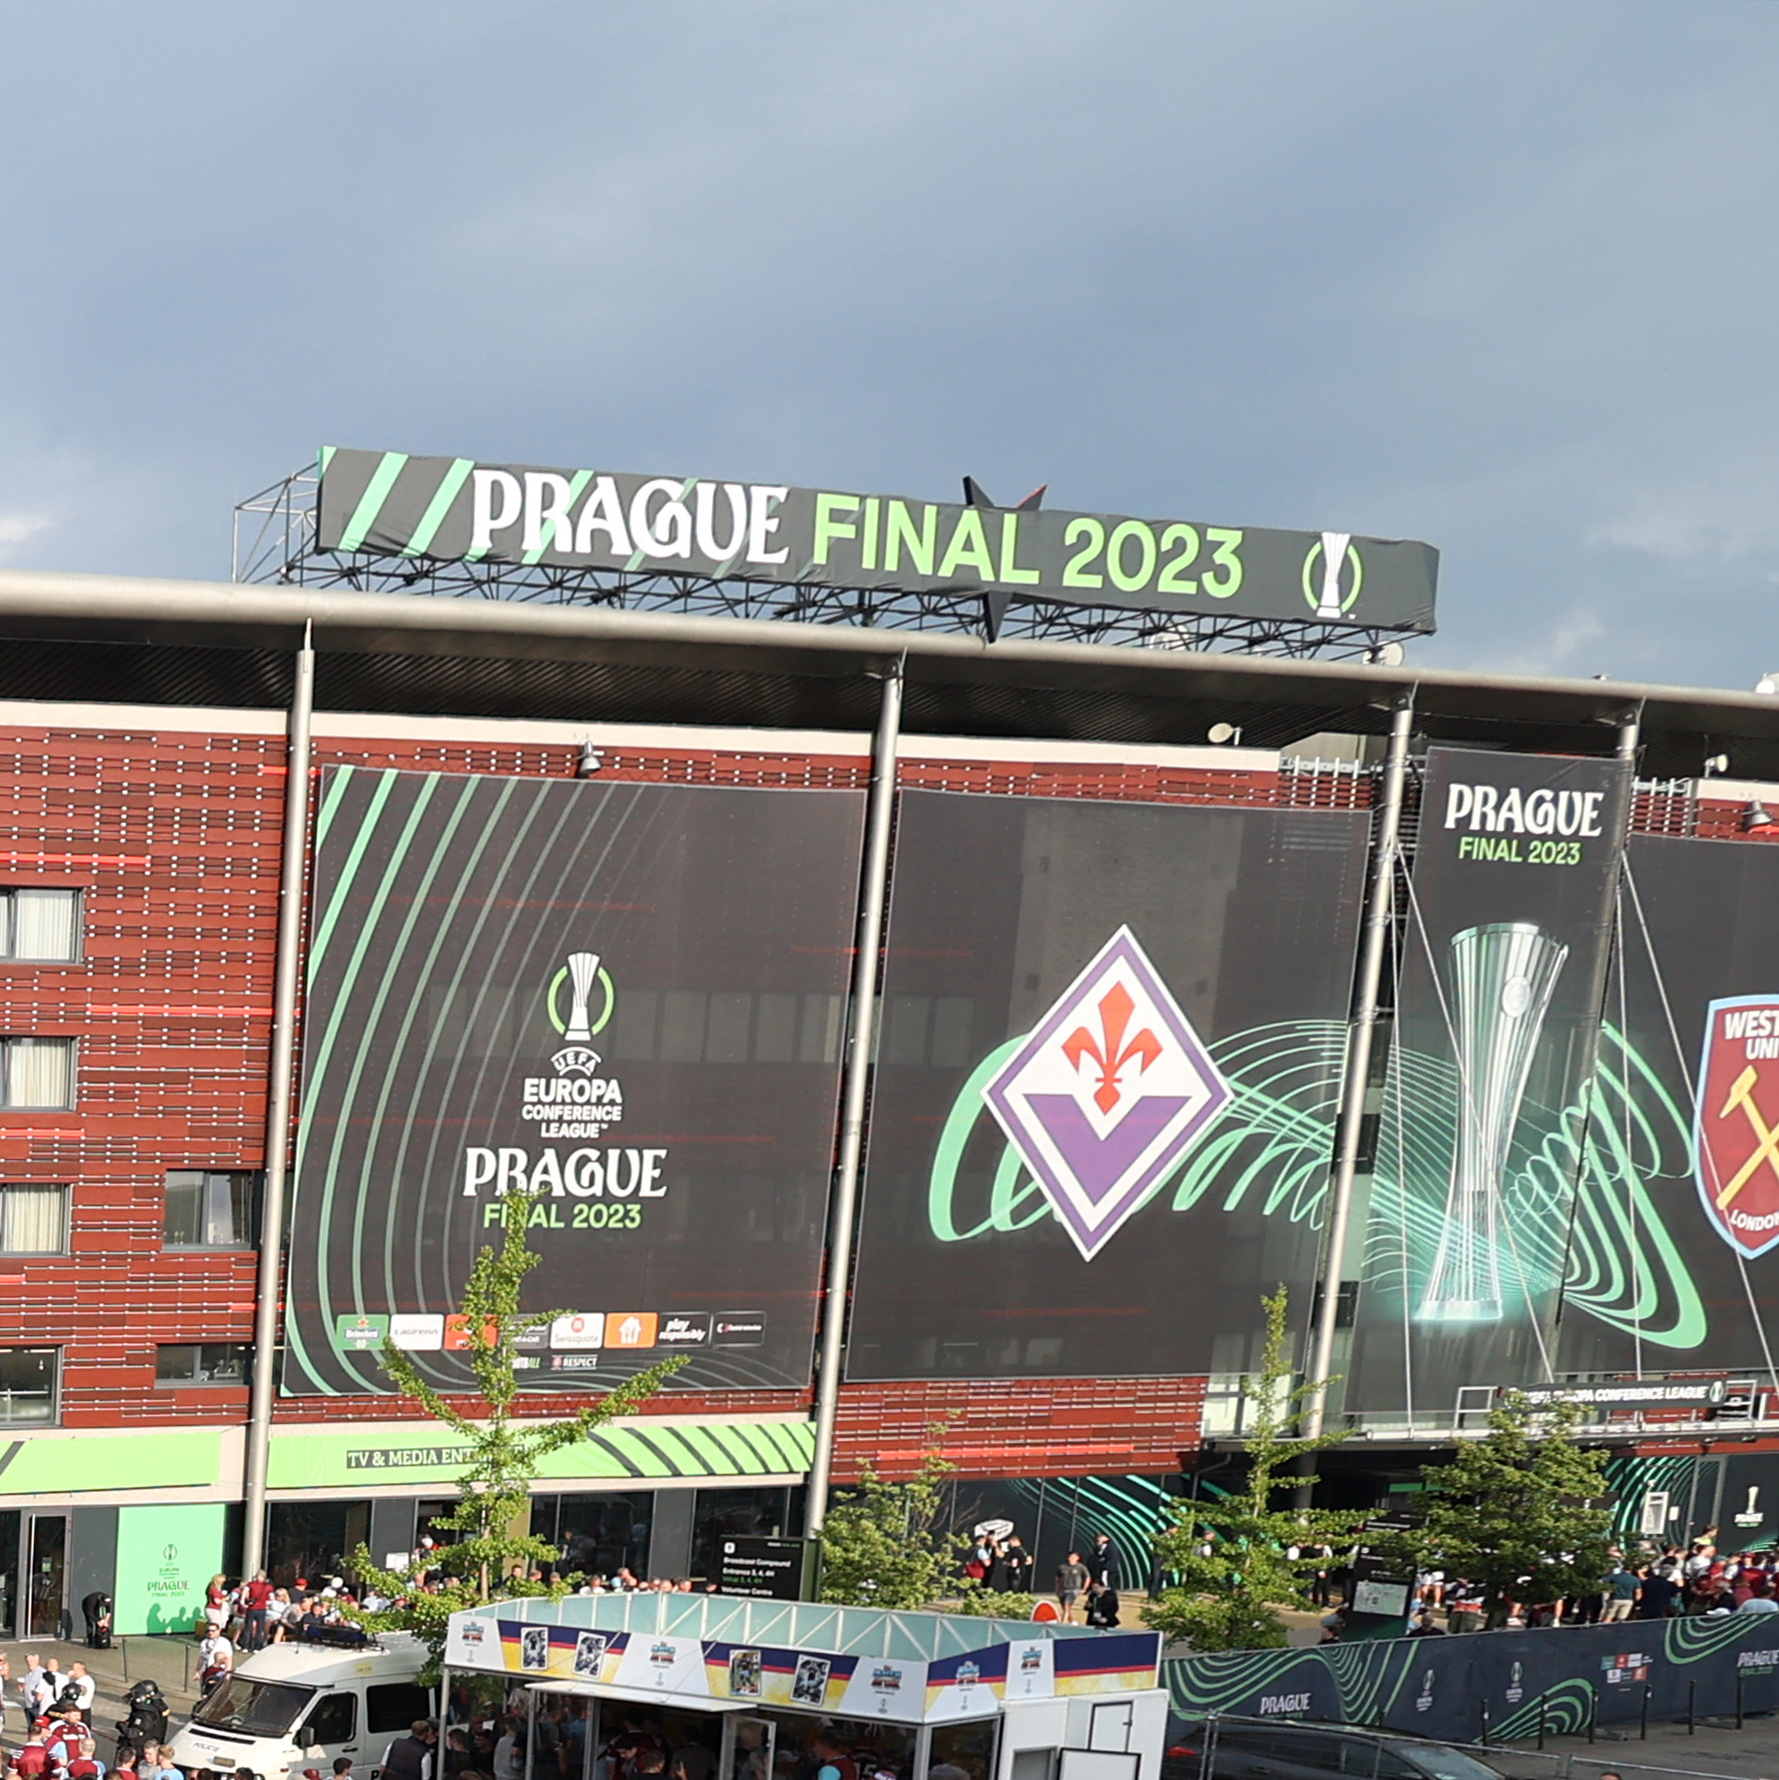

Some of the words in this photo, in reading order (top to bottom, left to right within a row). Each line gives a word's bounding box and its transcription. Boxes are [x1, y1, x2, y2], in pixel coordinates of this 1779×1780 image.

[470, 468, 793, 564] PRAGUE
[812, 492, 1040, 585] FINAL
[1062, 516, 1244, 599] 2023
[1444, 783, 1604, 837] PRAGUE
[1458, 836, 1523, 862] FINAL
[1527, 840, 1582, 865] 2023
[553, 1051, 598, 1072] UEFA
[523, 1077, 623, 1104] EUROPA
[522, 1104, 622, 1122] CONFERENCE
[463, 1147, 668, 1198] PRAGUE
[483, 1203, 565, 1229] FIAL
[572, 1203, 642, 1229] 2023
[666, 1318, 691, 1332] play
[555, 1334, 599, 1345] Swissquote
[563, 1358, 598, 1367] RESPECT
[1595, 1387, 1664, 1401] CONFERENCE
[1665, 1385, 1709, 1400] LEAGUE
[348, 1452, 370, 1467] TV
[372, 1451, 386, 1467] &
[389, 1449, 439, 1466] MEDIA
[147, 1580, 190, 1591] PRAGUE
[1260, 1693, 1312, 1714] PRAGUE
